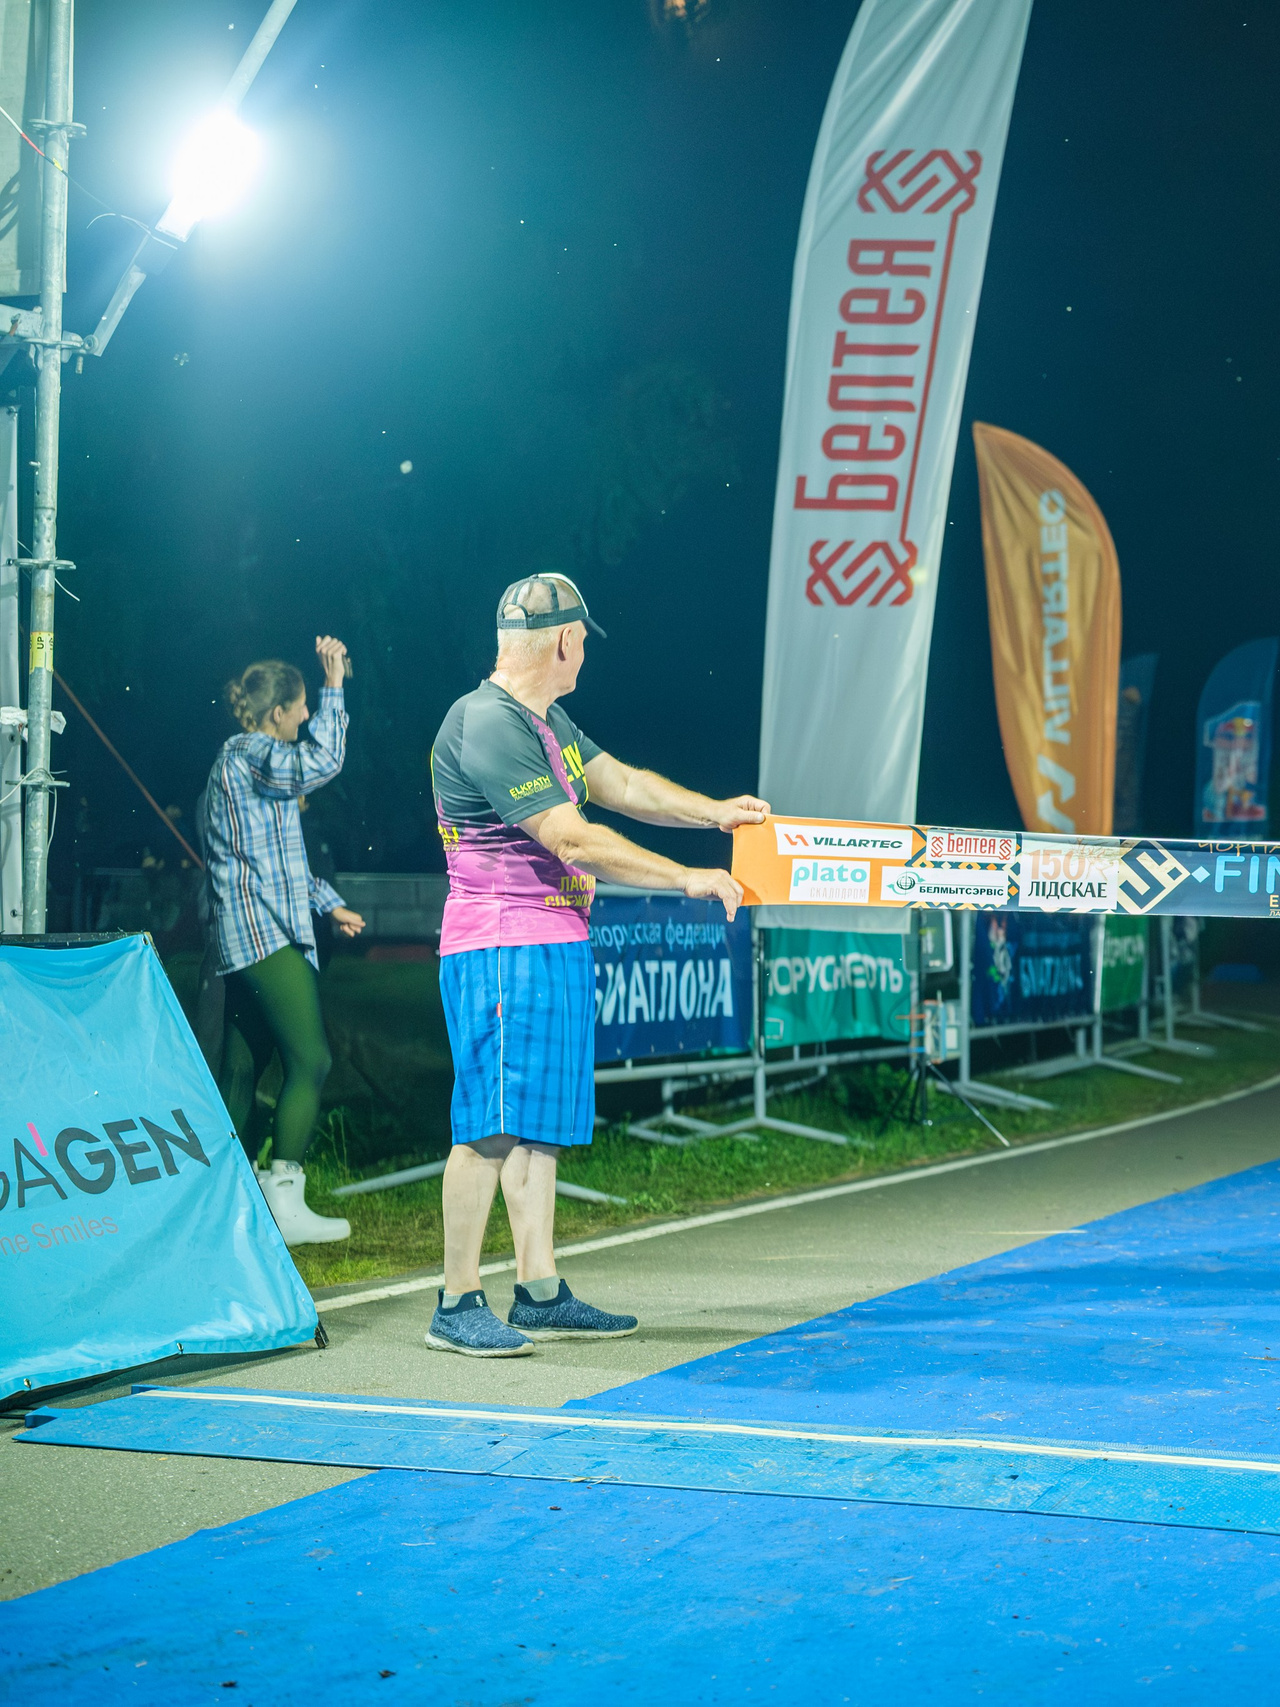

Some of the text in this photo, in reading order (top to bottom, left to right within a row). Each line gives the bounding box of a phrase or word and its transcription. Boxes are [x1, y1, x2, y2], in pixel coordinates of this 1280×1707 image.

[794, 239, 936, 511] Белтея
[509, 775, 551, 797] ELKPATH
[813, 836, 903, 849] VILLARTEC
[947, 833, 996, 854] Белтея
[793, 862, 867, 886] plato
[919, 885, 1004, 897] БЕЛМЫТСЭРВІС
[1028, 881, 1108, 898] ЛІДСКАЕ
[31, 1215, 119, 1249] Smiles
